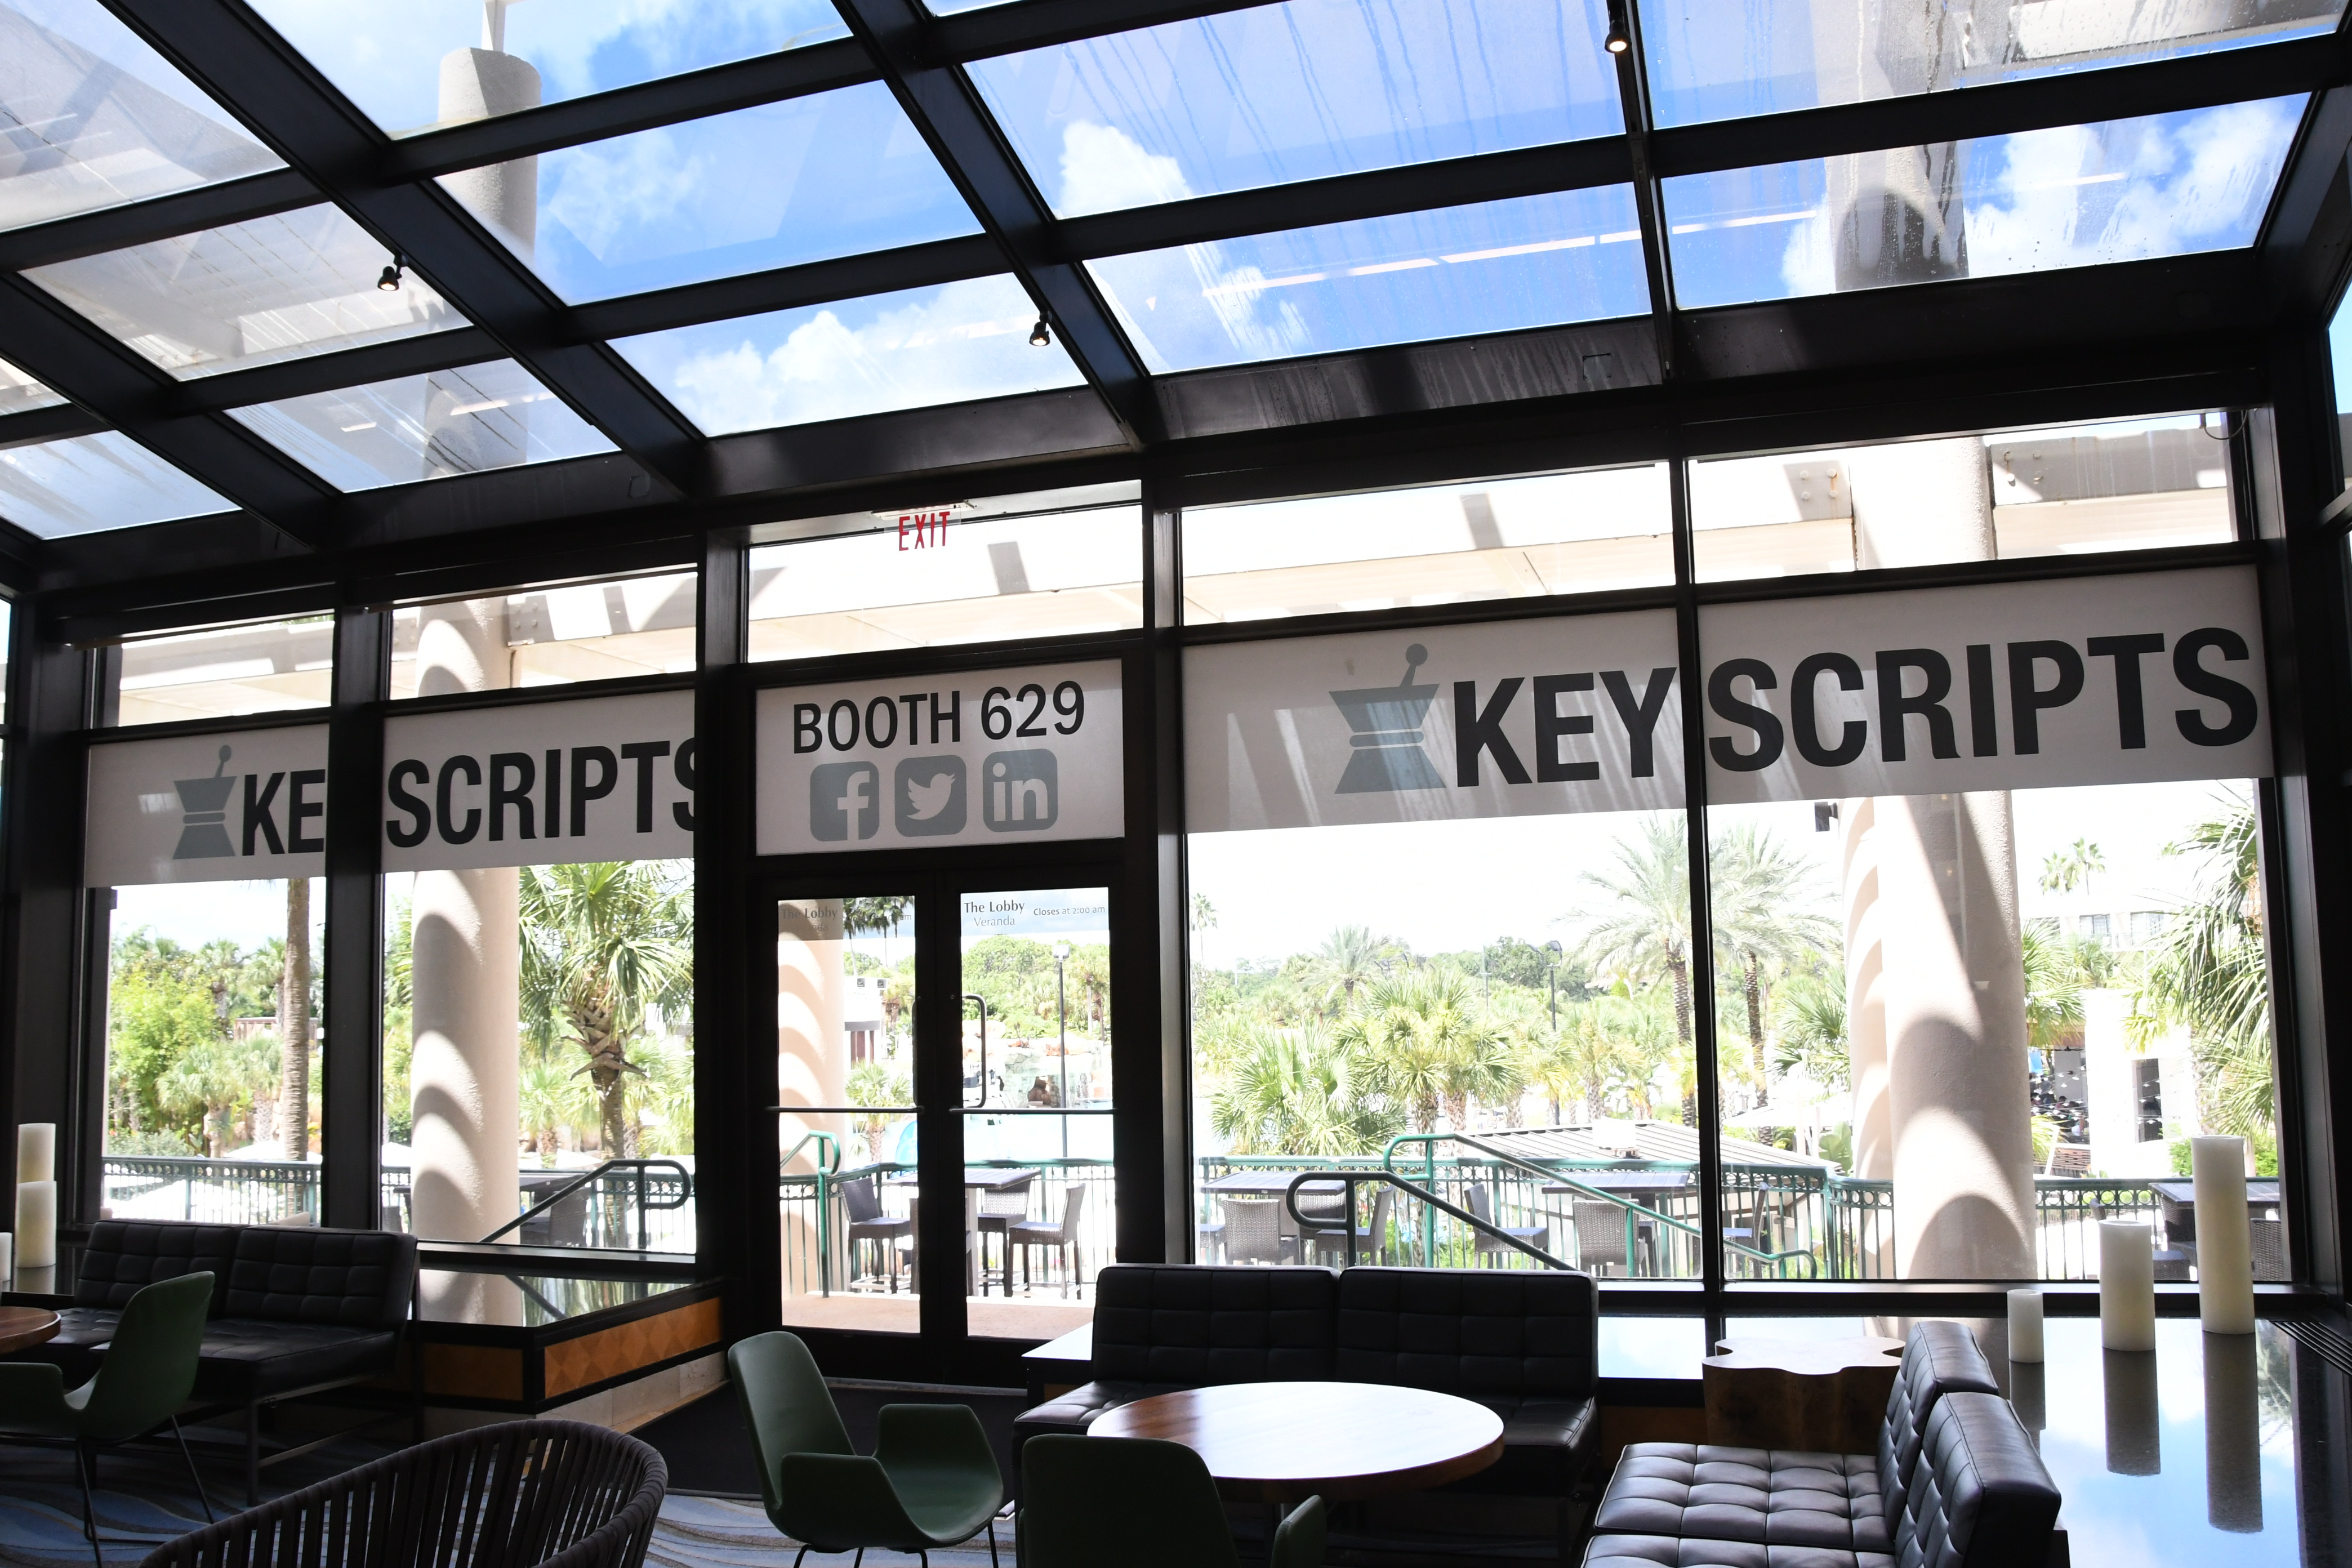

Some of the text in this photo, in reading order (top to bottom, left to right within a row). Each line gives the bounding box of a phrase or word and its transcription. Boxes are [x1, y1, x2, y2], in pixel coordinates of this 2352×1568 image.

[899, 511, 950, 551] EXIT
[794, 680, 1085, 754] BOOTH 629
[1453, 626, 2259, 788] KEY SCRIPTS
[242, 769, 326, 856] KE
[992, 762, 1048, 822] in
[805, 907, 838, 921] Lobby
[964, 899, 1025, 914] The Lobby
[974, 915, 1015, 926] Veranda
